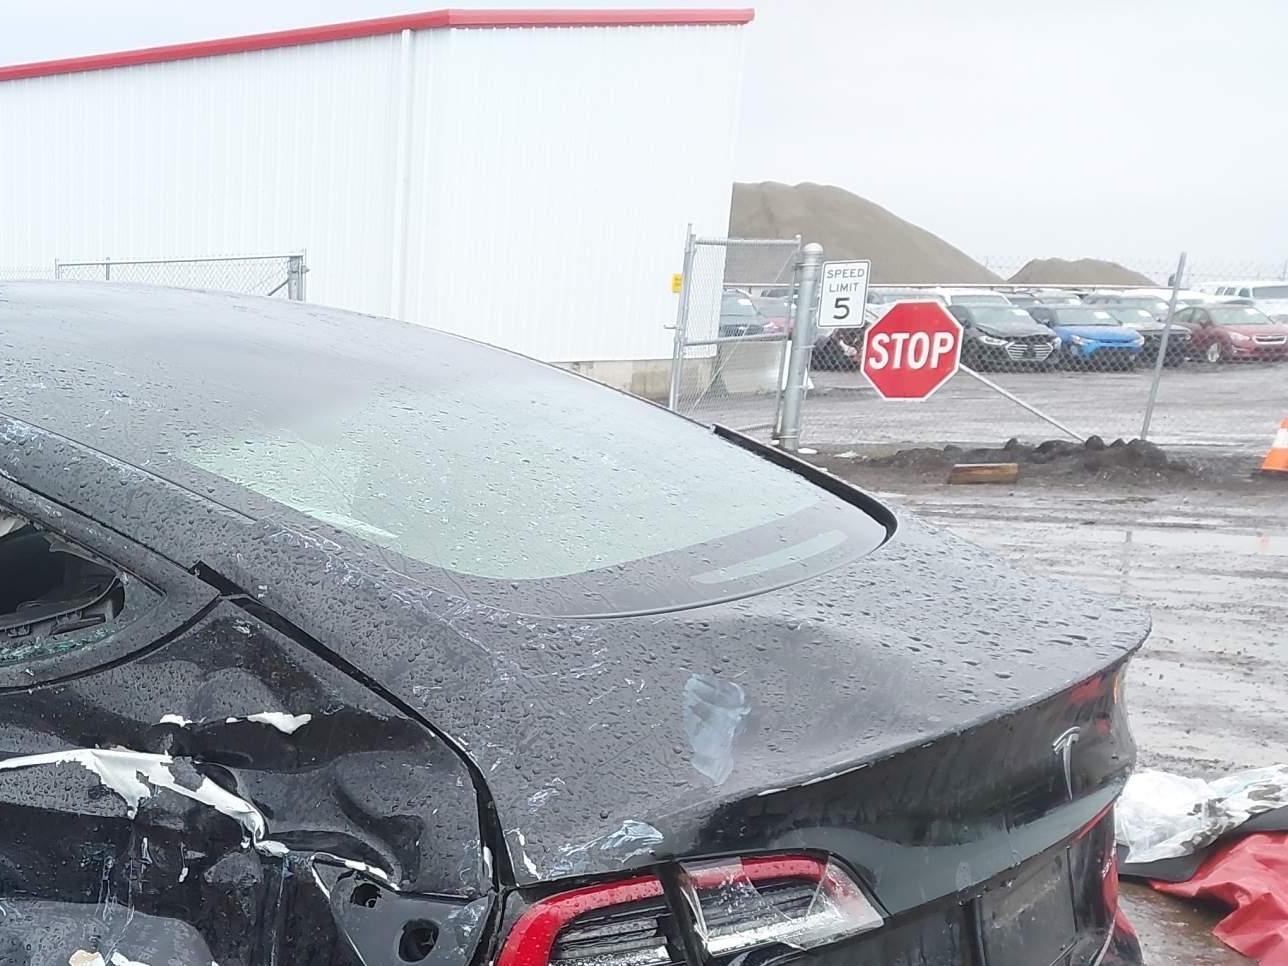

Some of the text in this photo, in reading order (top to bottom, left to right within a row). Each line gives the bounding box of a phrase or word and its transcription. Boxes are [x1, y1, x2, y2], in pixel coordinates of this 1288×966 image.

[827, 268, 865, 279] SPEED
[829, 282, 859, 293] LIMIT
[832, 297, 850, 320] 5
[869, 331, 955, 370] STOP
